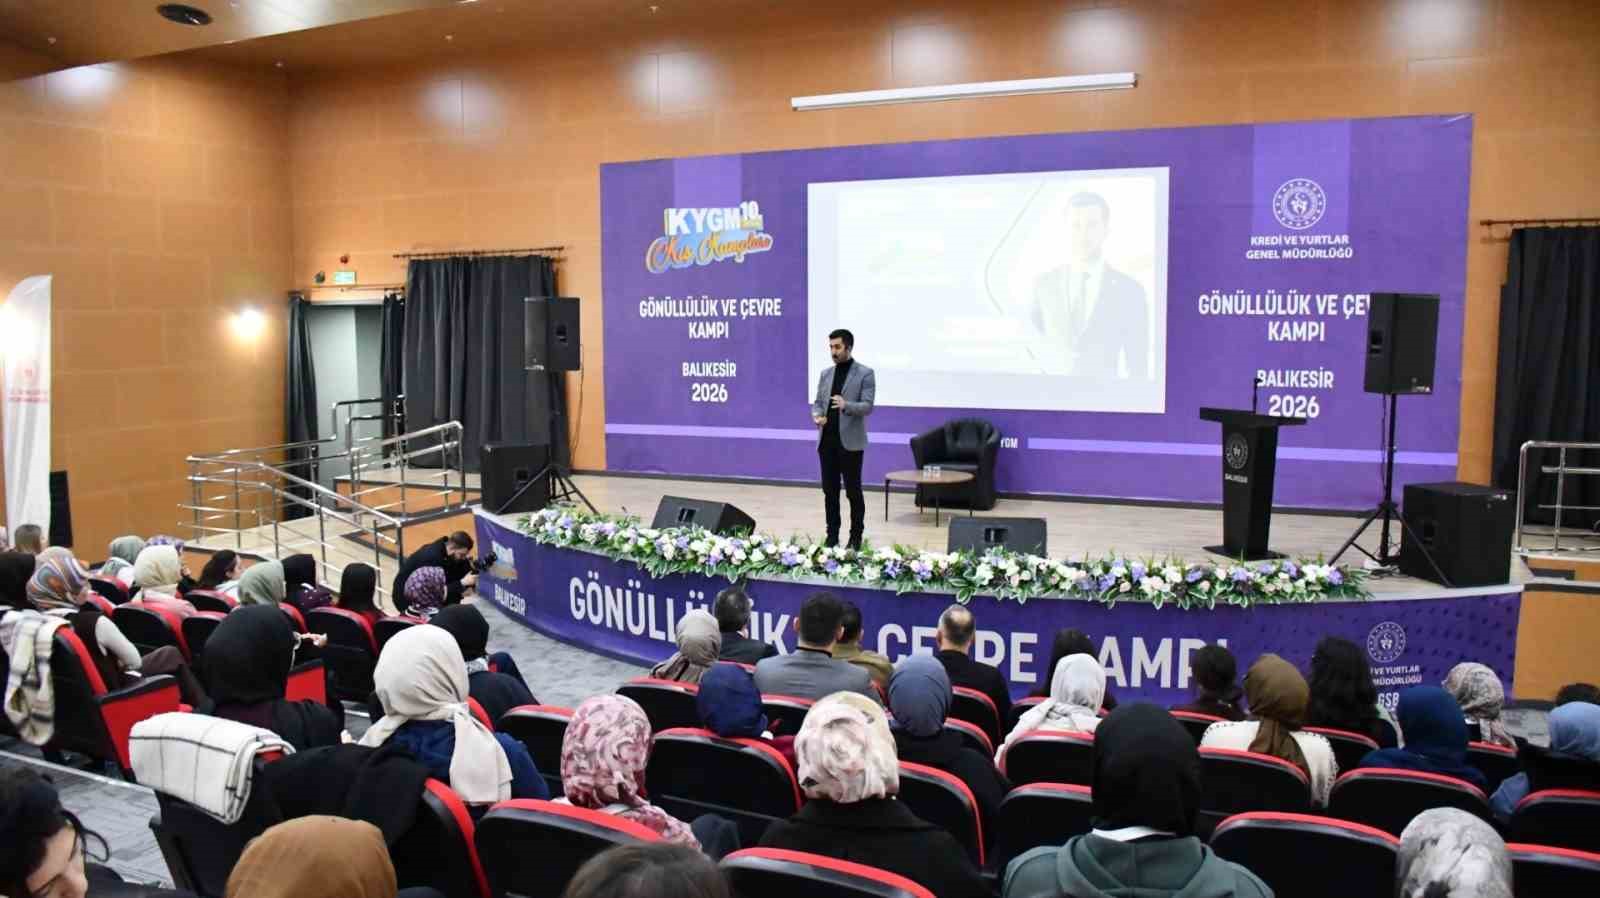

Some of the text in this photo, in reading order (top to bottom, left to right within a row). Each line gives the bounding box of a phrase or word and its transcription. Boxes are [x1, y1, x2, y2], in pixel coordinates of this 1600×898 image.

[664, 207, 741, 236] KYGM
[1250, 234, 1350, 246] KREDİ VE YURTLAR
[1246, 247, 1353, 260] GENEL MÜDÜRLÜĞÜ
[639, 296, 782, 320] GÖNÜLLÜLÜK VE ÇEVRE
[1198, 289, 1311, 316] GÖNÜLLÜLÜK
[1316, 294, 1338, 316] VE
[688, 321, 729, 340] KAMPI
[1268, 321, 1325, 342] KAMPI
[682, 359, 737, 378] BALIKESİR
[1256, 366, 1334, 389] BALIKESİR
[691, 382, 729, 403] 2026
[1268, 394, 1320, 419] 2026
[1386, 664, 1420, 675] YURTLAR
